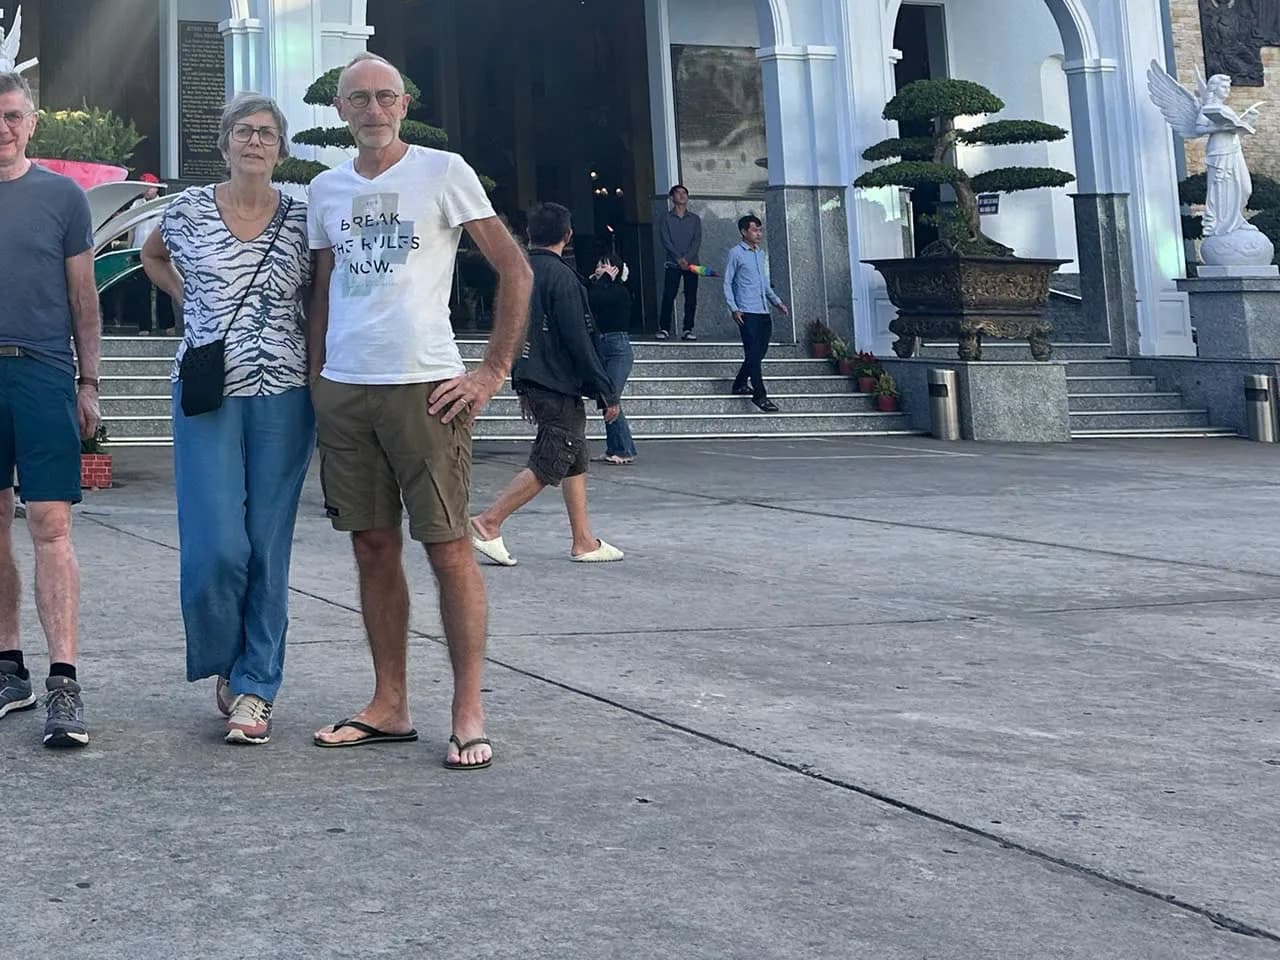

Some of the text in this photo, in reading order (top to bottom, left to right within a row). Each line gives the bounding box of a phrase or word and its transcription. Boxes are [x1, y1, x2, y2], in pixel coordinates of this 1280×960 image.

[340, 212, 401, 231] BREAK
[331, 235, 421, 255] THE RULES
[349, 259, 394, 275] NOW.
